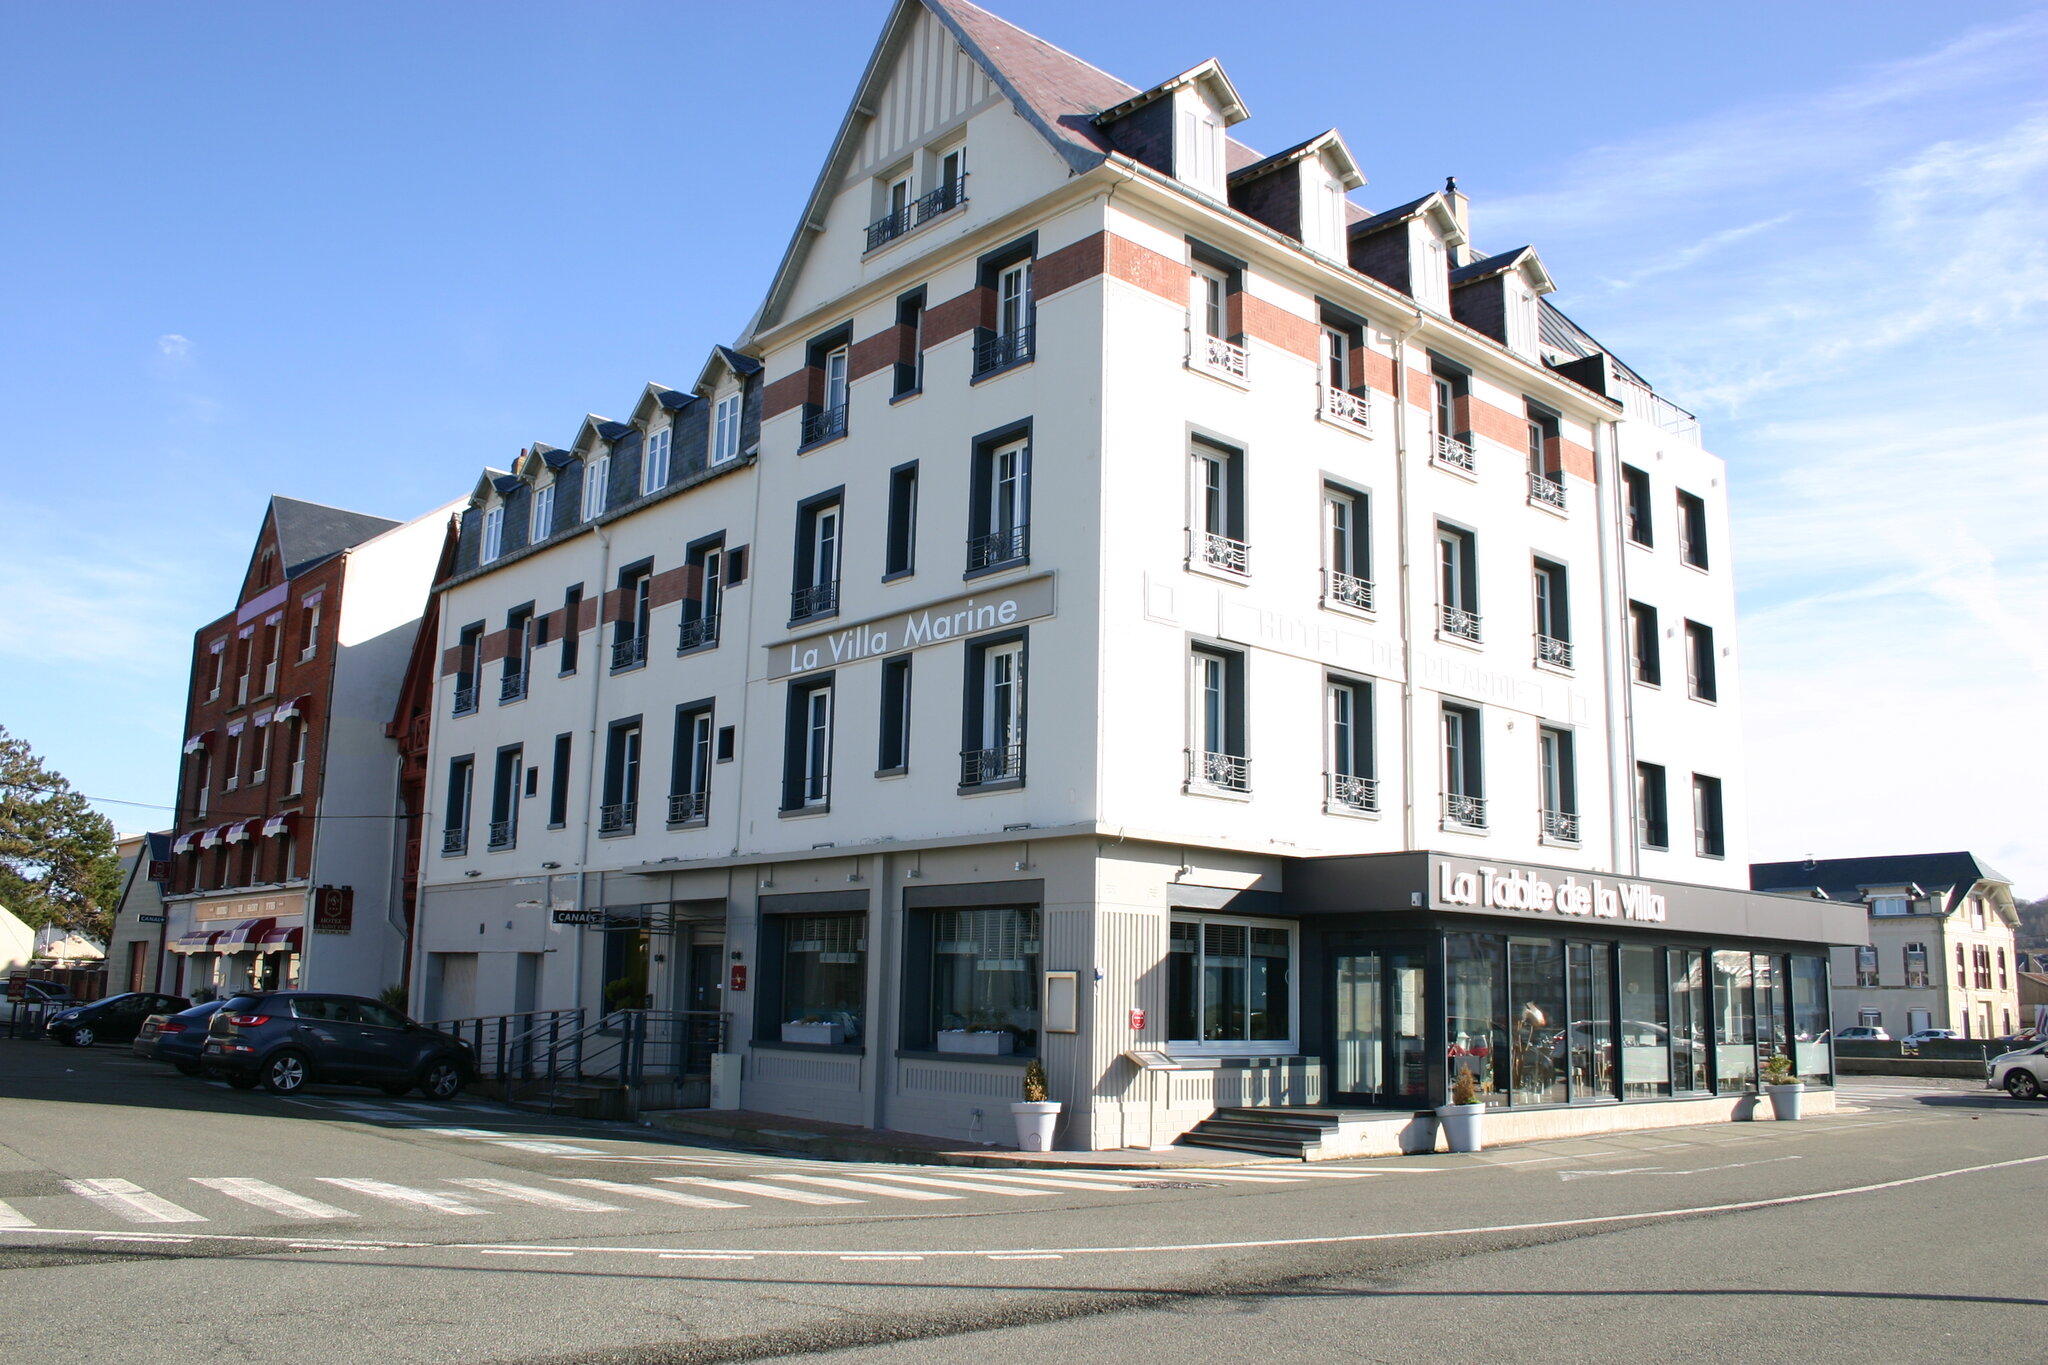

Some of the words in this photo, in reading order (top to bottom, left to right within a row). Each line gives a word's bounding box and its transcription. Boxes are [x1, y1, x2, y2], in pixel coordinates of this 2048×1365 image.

[790, 644, 818, 673] La
[828, 625, 888, 663] Villa
[903, 599, 1018, 647] Marine
[1440, 861, 1477, 905] La
[1480, 866, 1553, 912] Table
[1556, 876, 1592, 915] de
[1592, 879, 1617, 917] la
[1618, 883, 1665, 922] Villa
